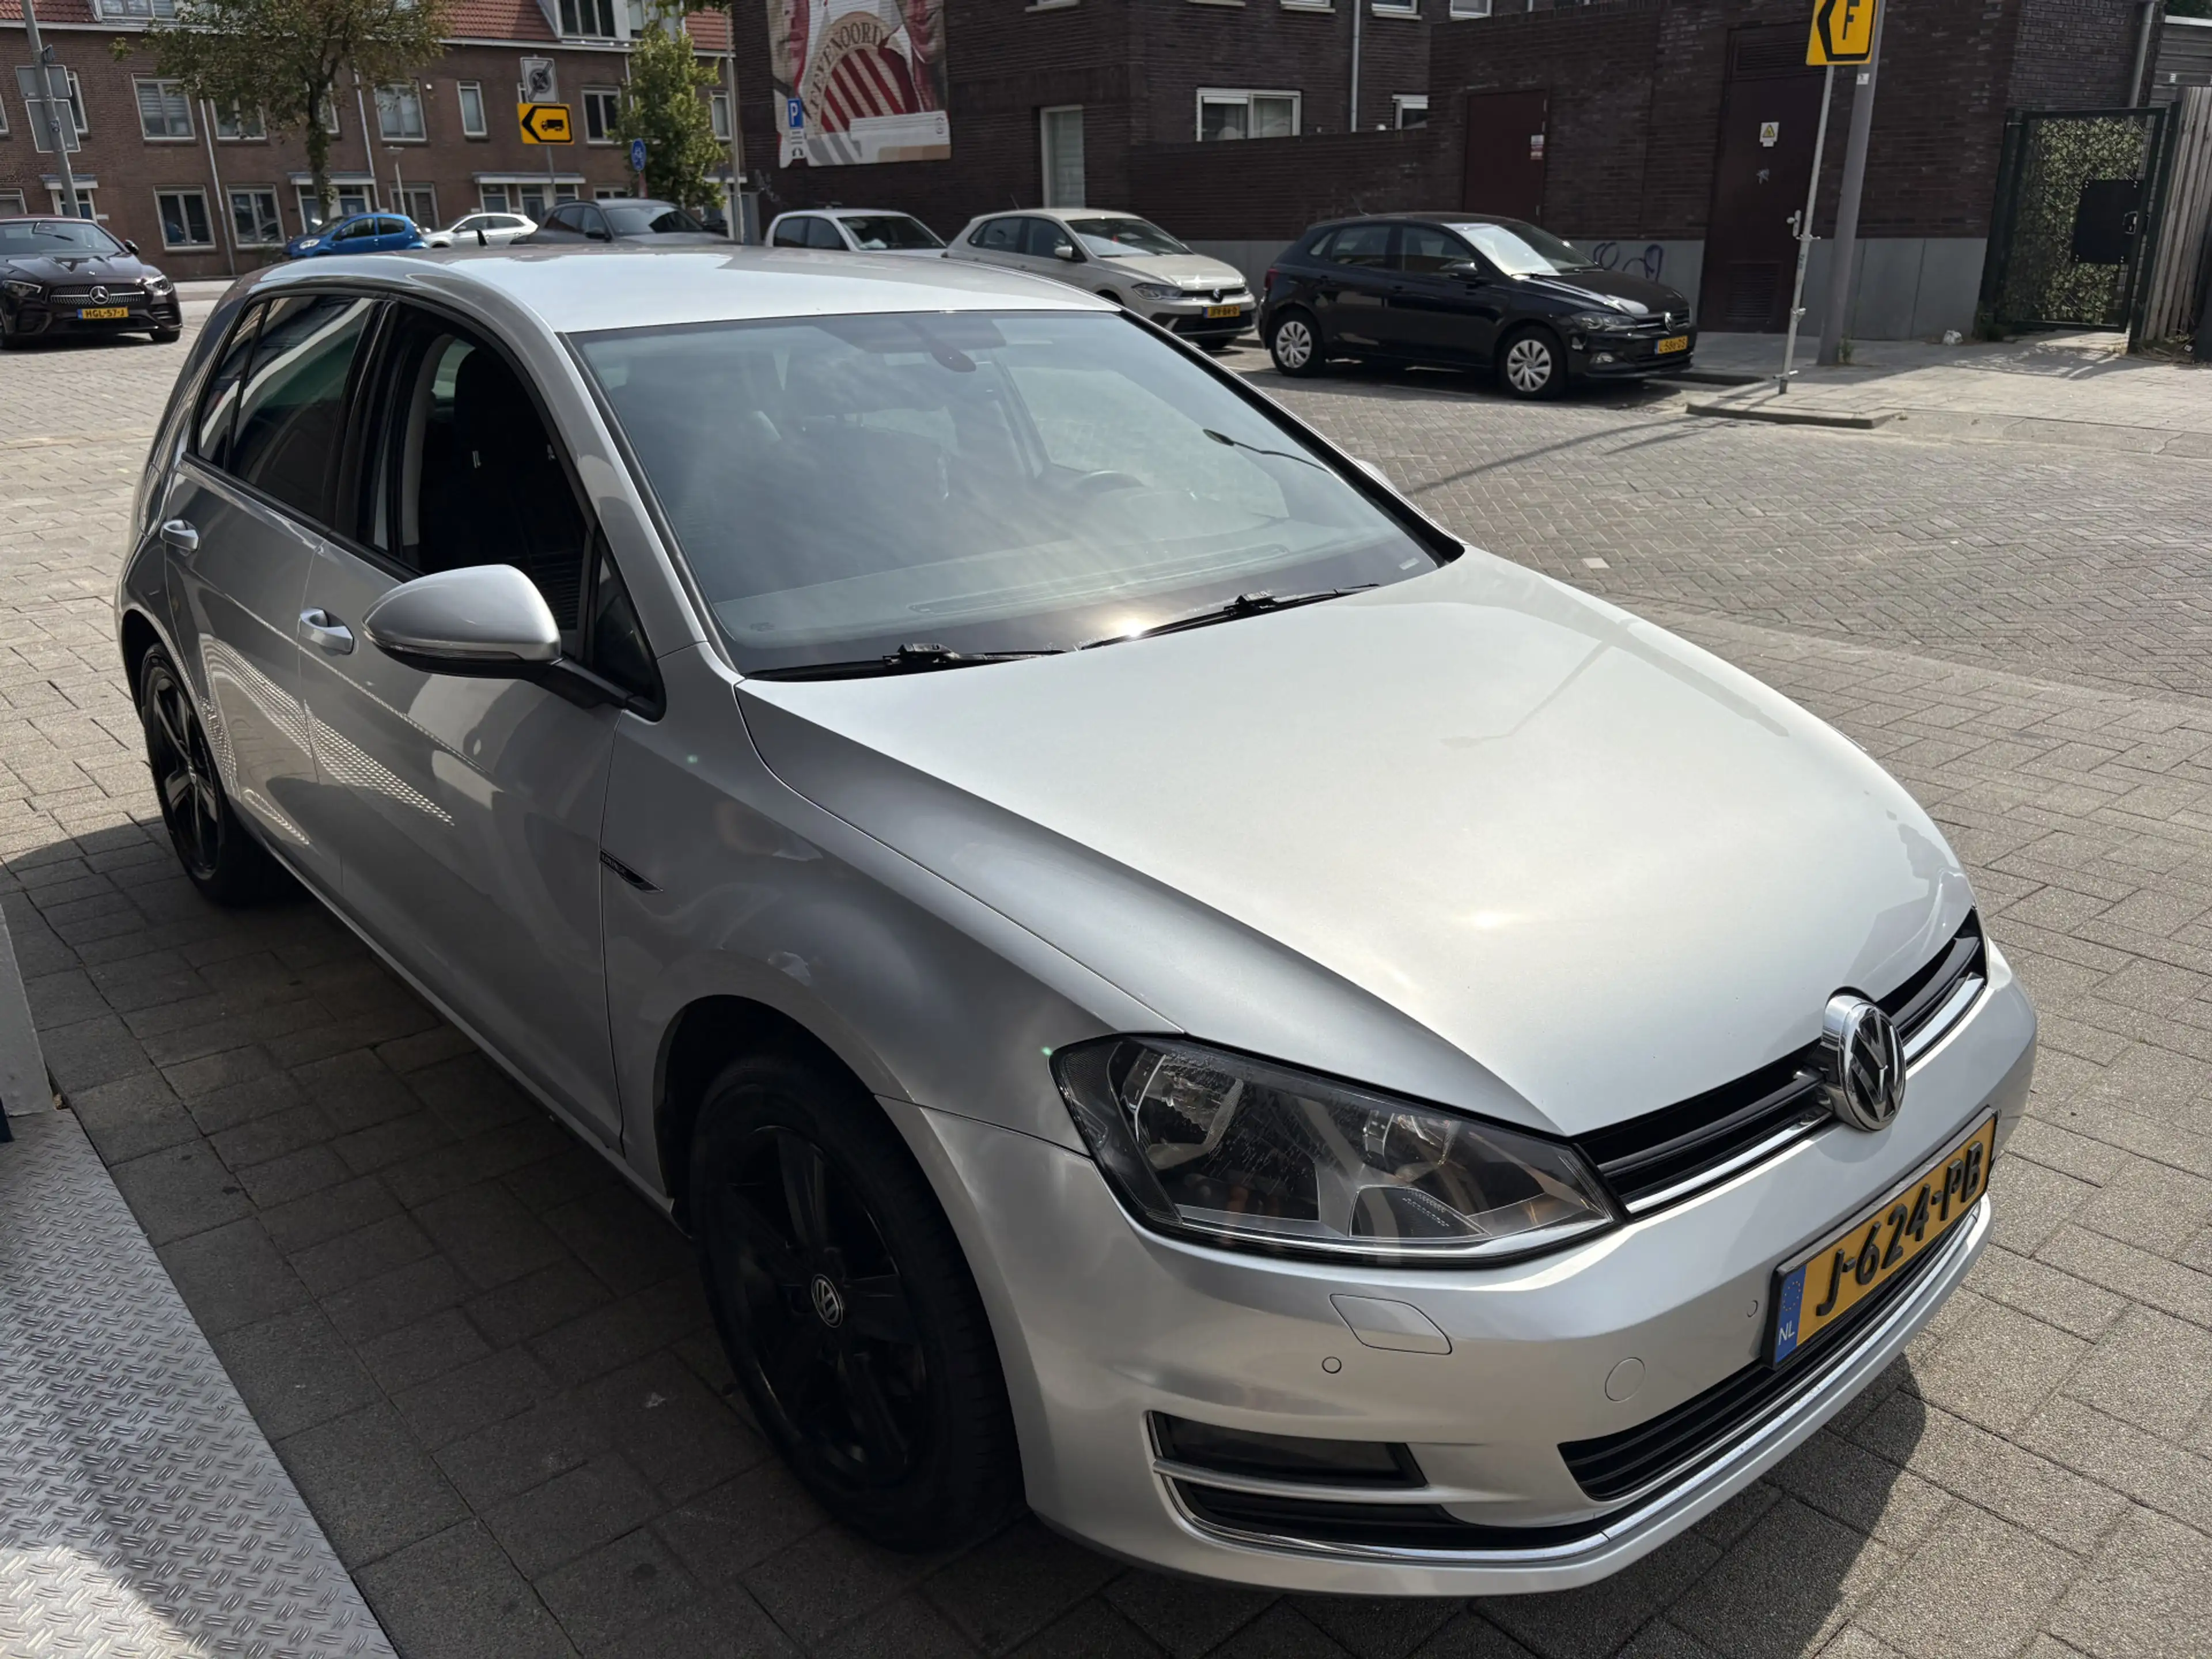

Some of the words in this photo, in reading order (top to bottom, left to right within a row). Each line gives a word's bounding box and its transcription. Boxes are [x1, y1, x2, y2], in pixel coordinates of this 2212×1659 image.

[1843, 0, 1860, 40] F
[790, 102, 798, 125] P
[85, 309, 124, 318] HGL-57-J
[1816, 1140, 1983, 1317] J-624-PB
[1778, 1319, 1796, 1346] NL
